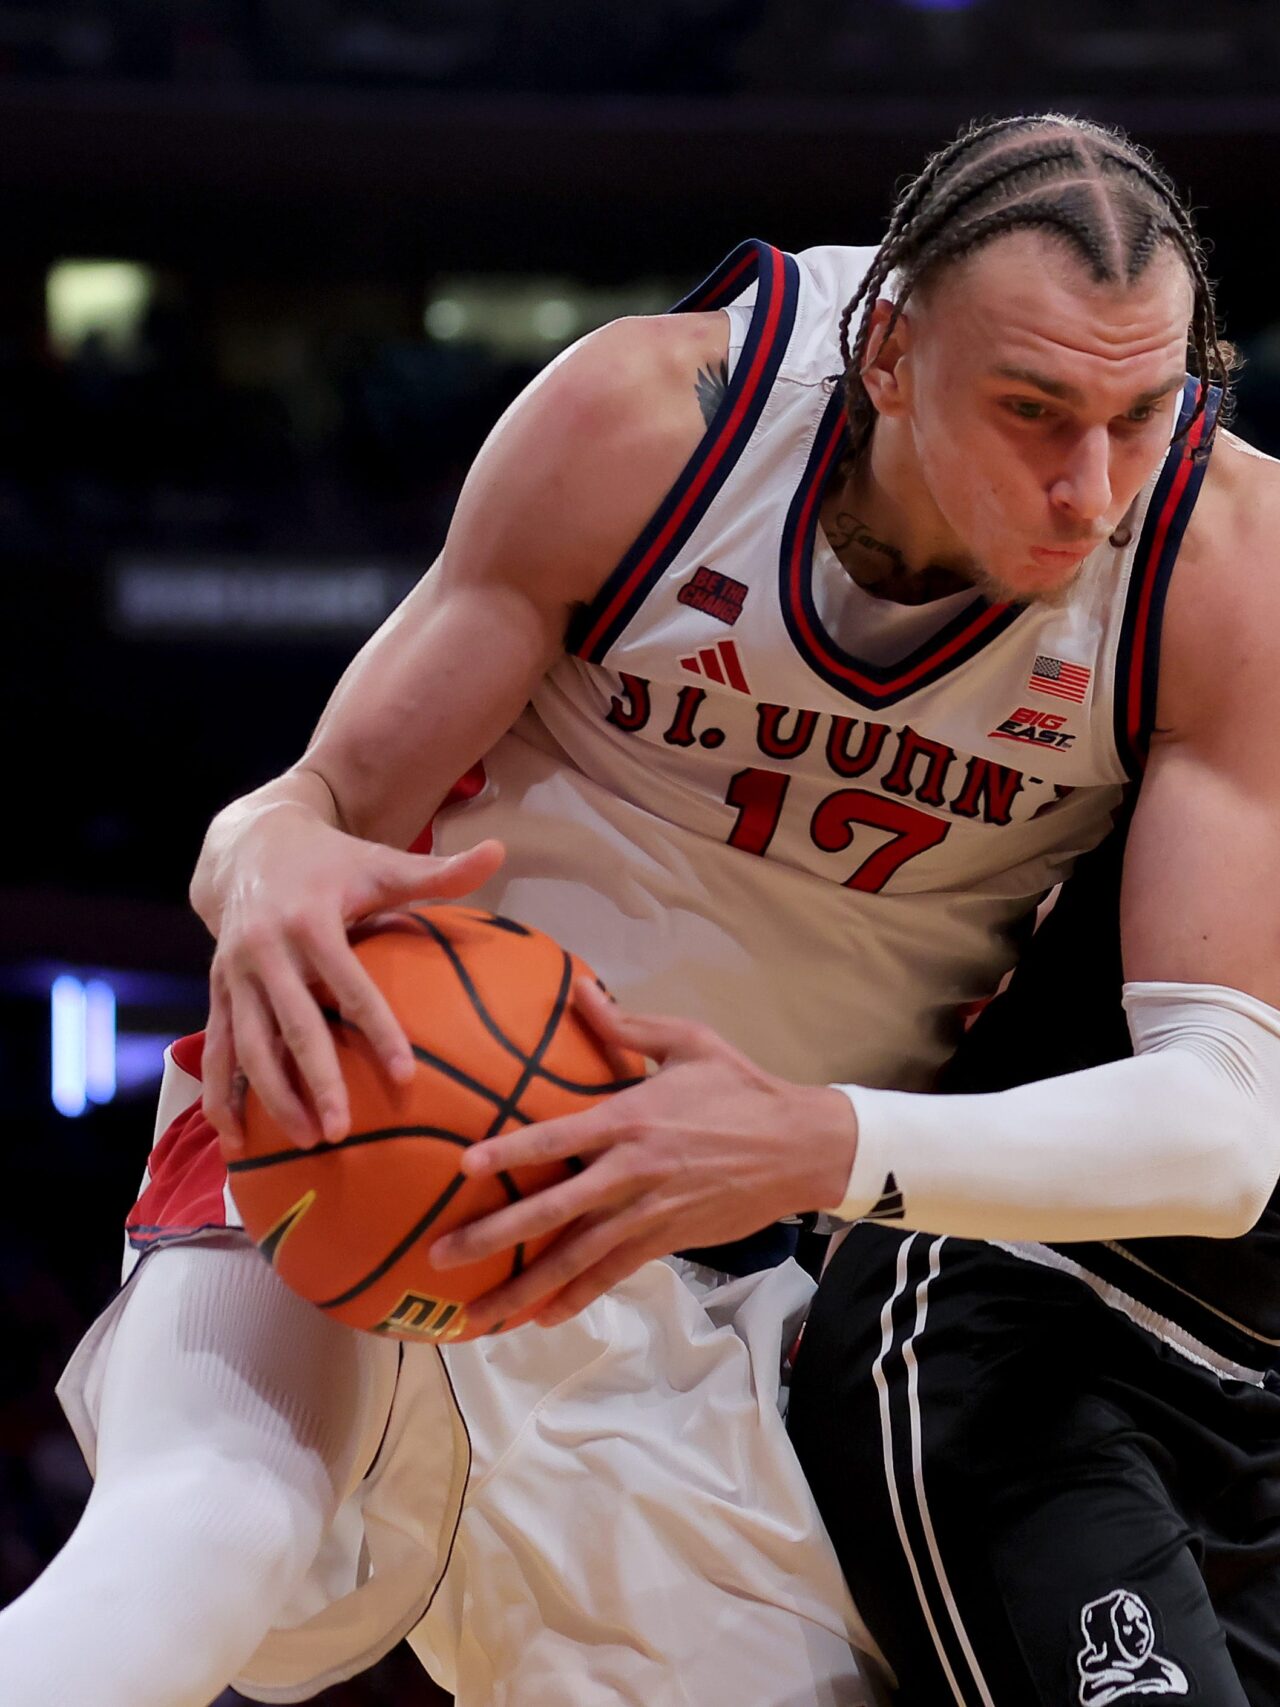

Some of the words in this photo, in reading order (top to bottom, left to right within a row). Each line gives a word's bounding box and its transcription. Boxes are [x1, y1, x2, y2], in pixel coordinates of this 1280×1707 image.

[1009, 707, 1068, 730] BIG
[996, 720, 1077, 747] EAST
[724, 767, 952, 894] 17
